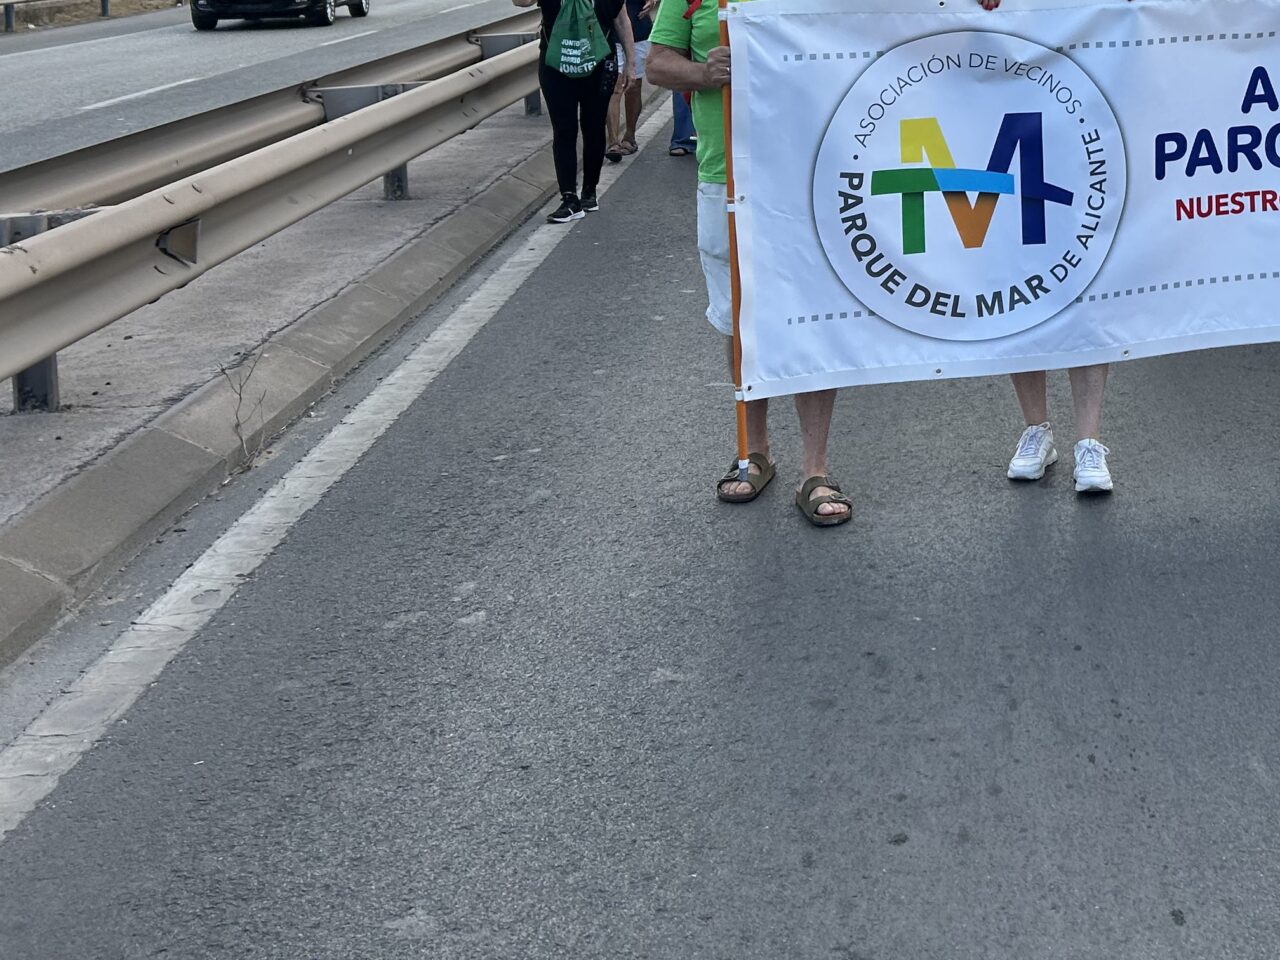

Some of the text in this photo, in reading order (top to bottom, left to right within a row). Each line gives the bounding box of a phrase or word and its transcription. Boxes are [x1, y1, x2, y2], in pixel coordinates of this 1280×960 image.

[854, 52, 1083, 149] ASOCIACIÓN DE VECINOS
[837, 128, 1108, 319] PARQUE DEL MAR DE ALICANTE
